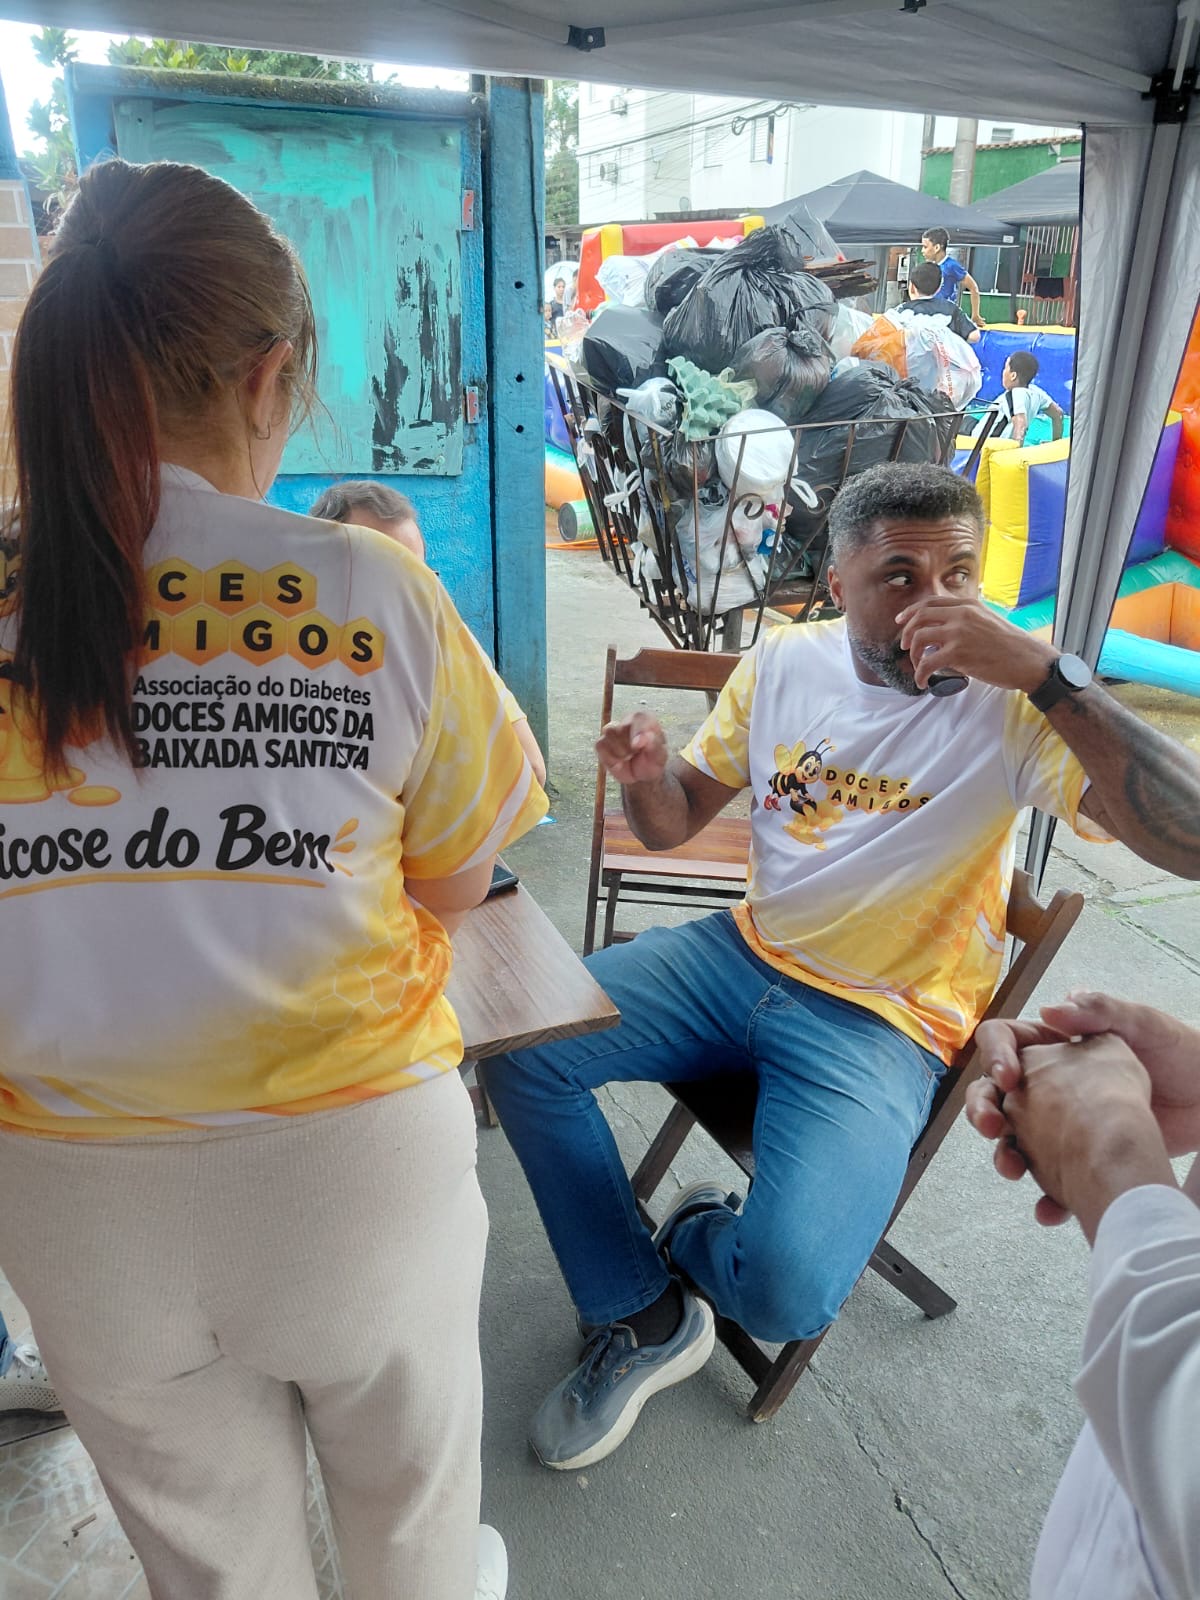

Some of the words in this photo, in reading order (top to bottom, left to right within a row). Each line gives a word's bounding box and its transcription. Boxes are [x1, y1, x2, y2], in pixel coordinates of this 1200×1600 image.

[157, 570, 303, 604] CES
[143, 619, 373, 663] MIGOS
[133, 675, 252, 702] Associação
[257, 676, 285, 697] do
[290, 678, 371, 707] Diabetes
[133, 702, 225, 733] DOCES
[232, 703, 338, 736] AMIGOS
[342, 709, 374, 742] DA
[134, 738, 260, 769] BAIXADA
[264, 739, 370, 770] SANTISTA
[825, 769, 909, 794] DOCES
[831, 789, 930, 810] AMIGOS
[125, 806, 201, 870] do
[215, 804, 335, 875] Bem
